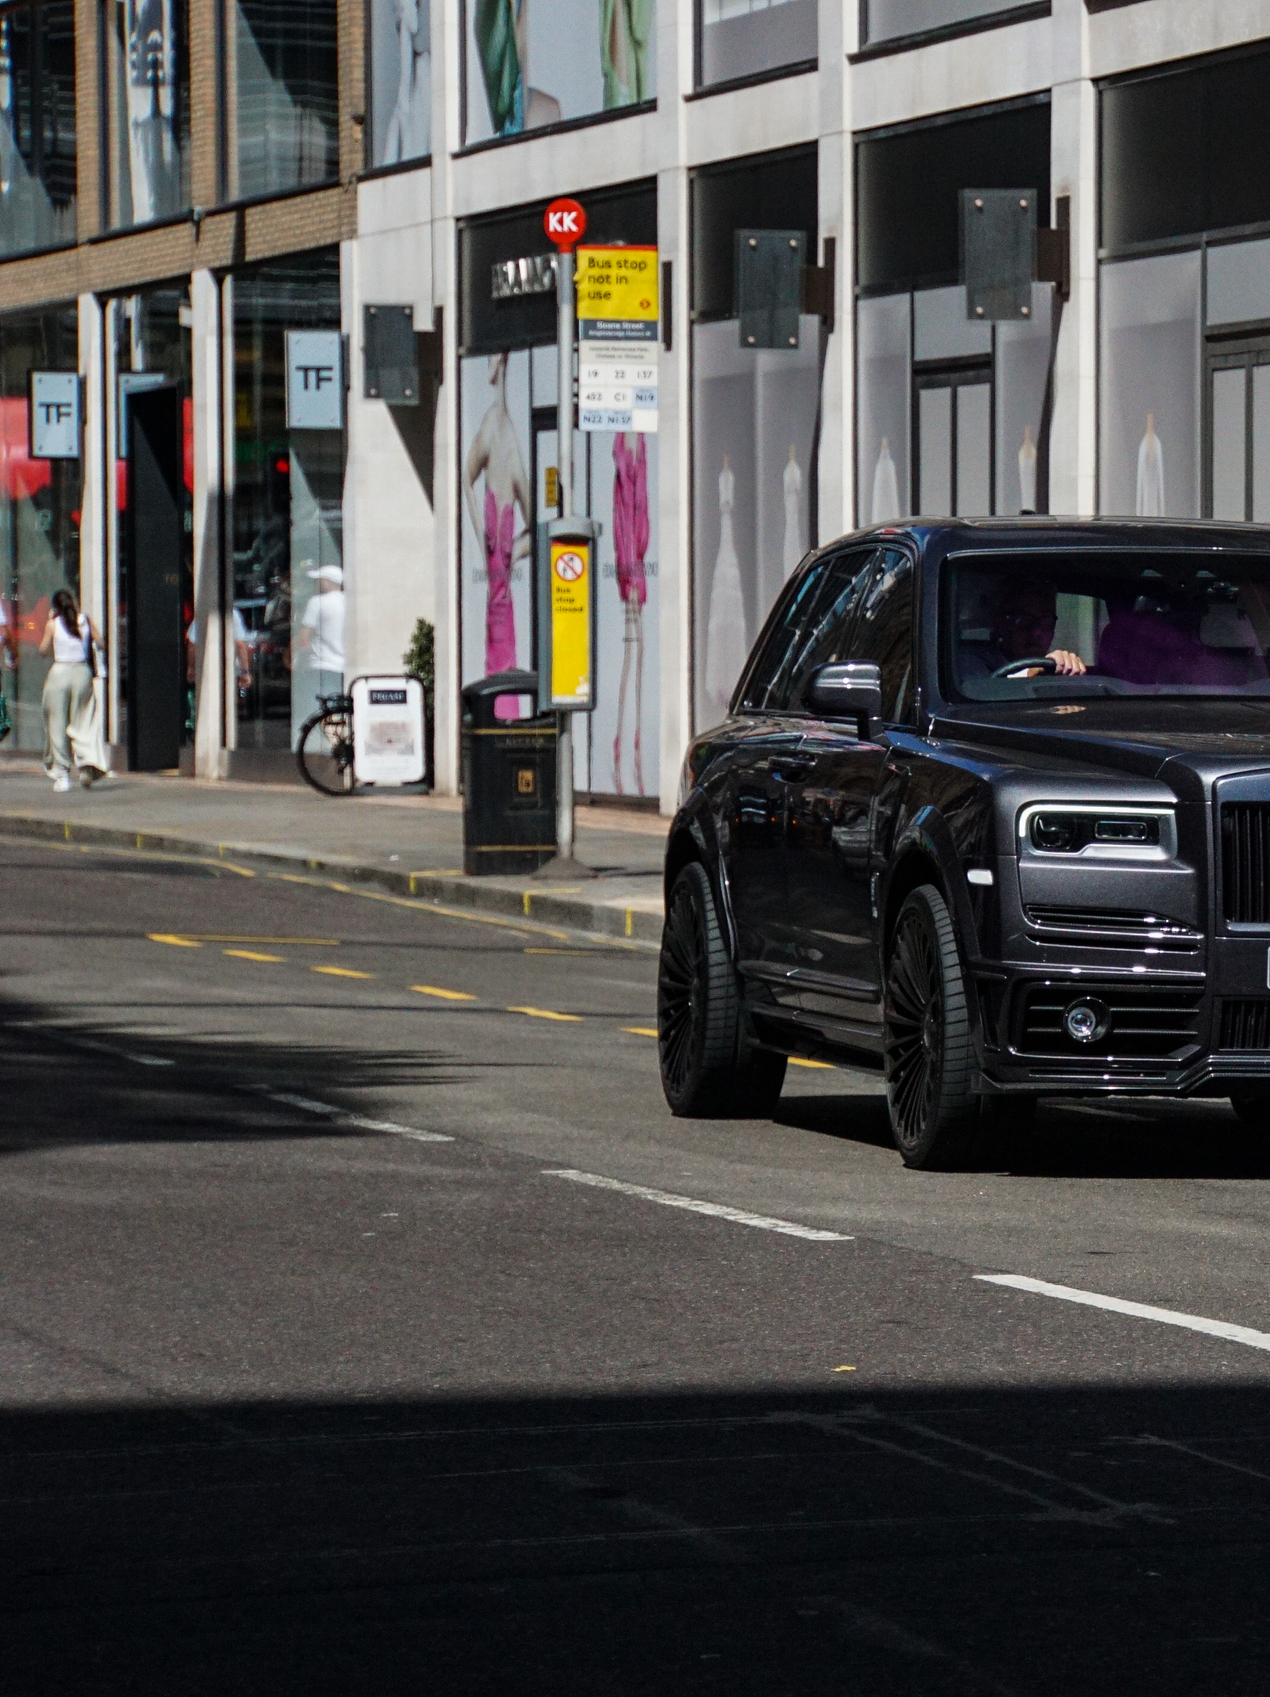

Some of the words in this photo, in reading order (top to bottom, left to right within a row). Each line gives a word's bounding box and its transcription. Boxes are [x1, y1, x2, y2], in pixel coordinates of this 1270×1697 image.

[548, 211, 579, 233] KK
[587, 256, 612, 269] Bus
[615, 258, 647, 273] stop
[587, 273, 612, 285] not
[615, 273, 629, 285] in
[587, 290, 612, 300] use
[294, 365, 334, 392] TF
[587, 369, 599, 379] 19
[614, 369, 626, 380] 22
[635, 393, 655, 402] N19
[38, 401, 73, 425] TF
